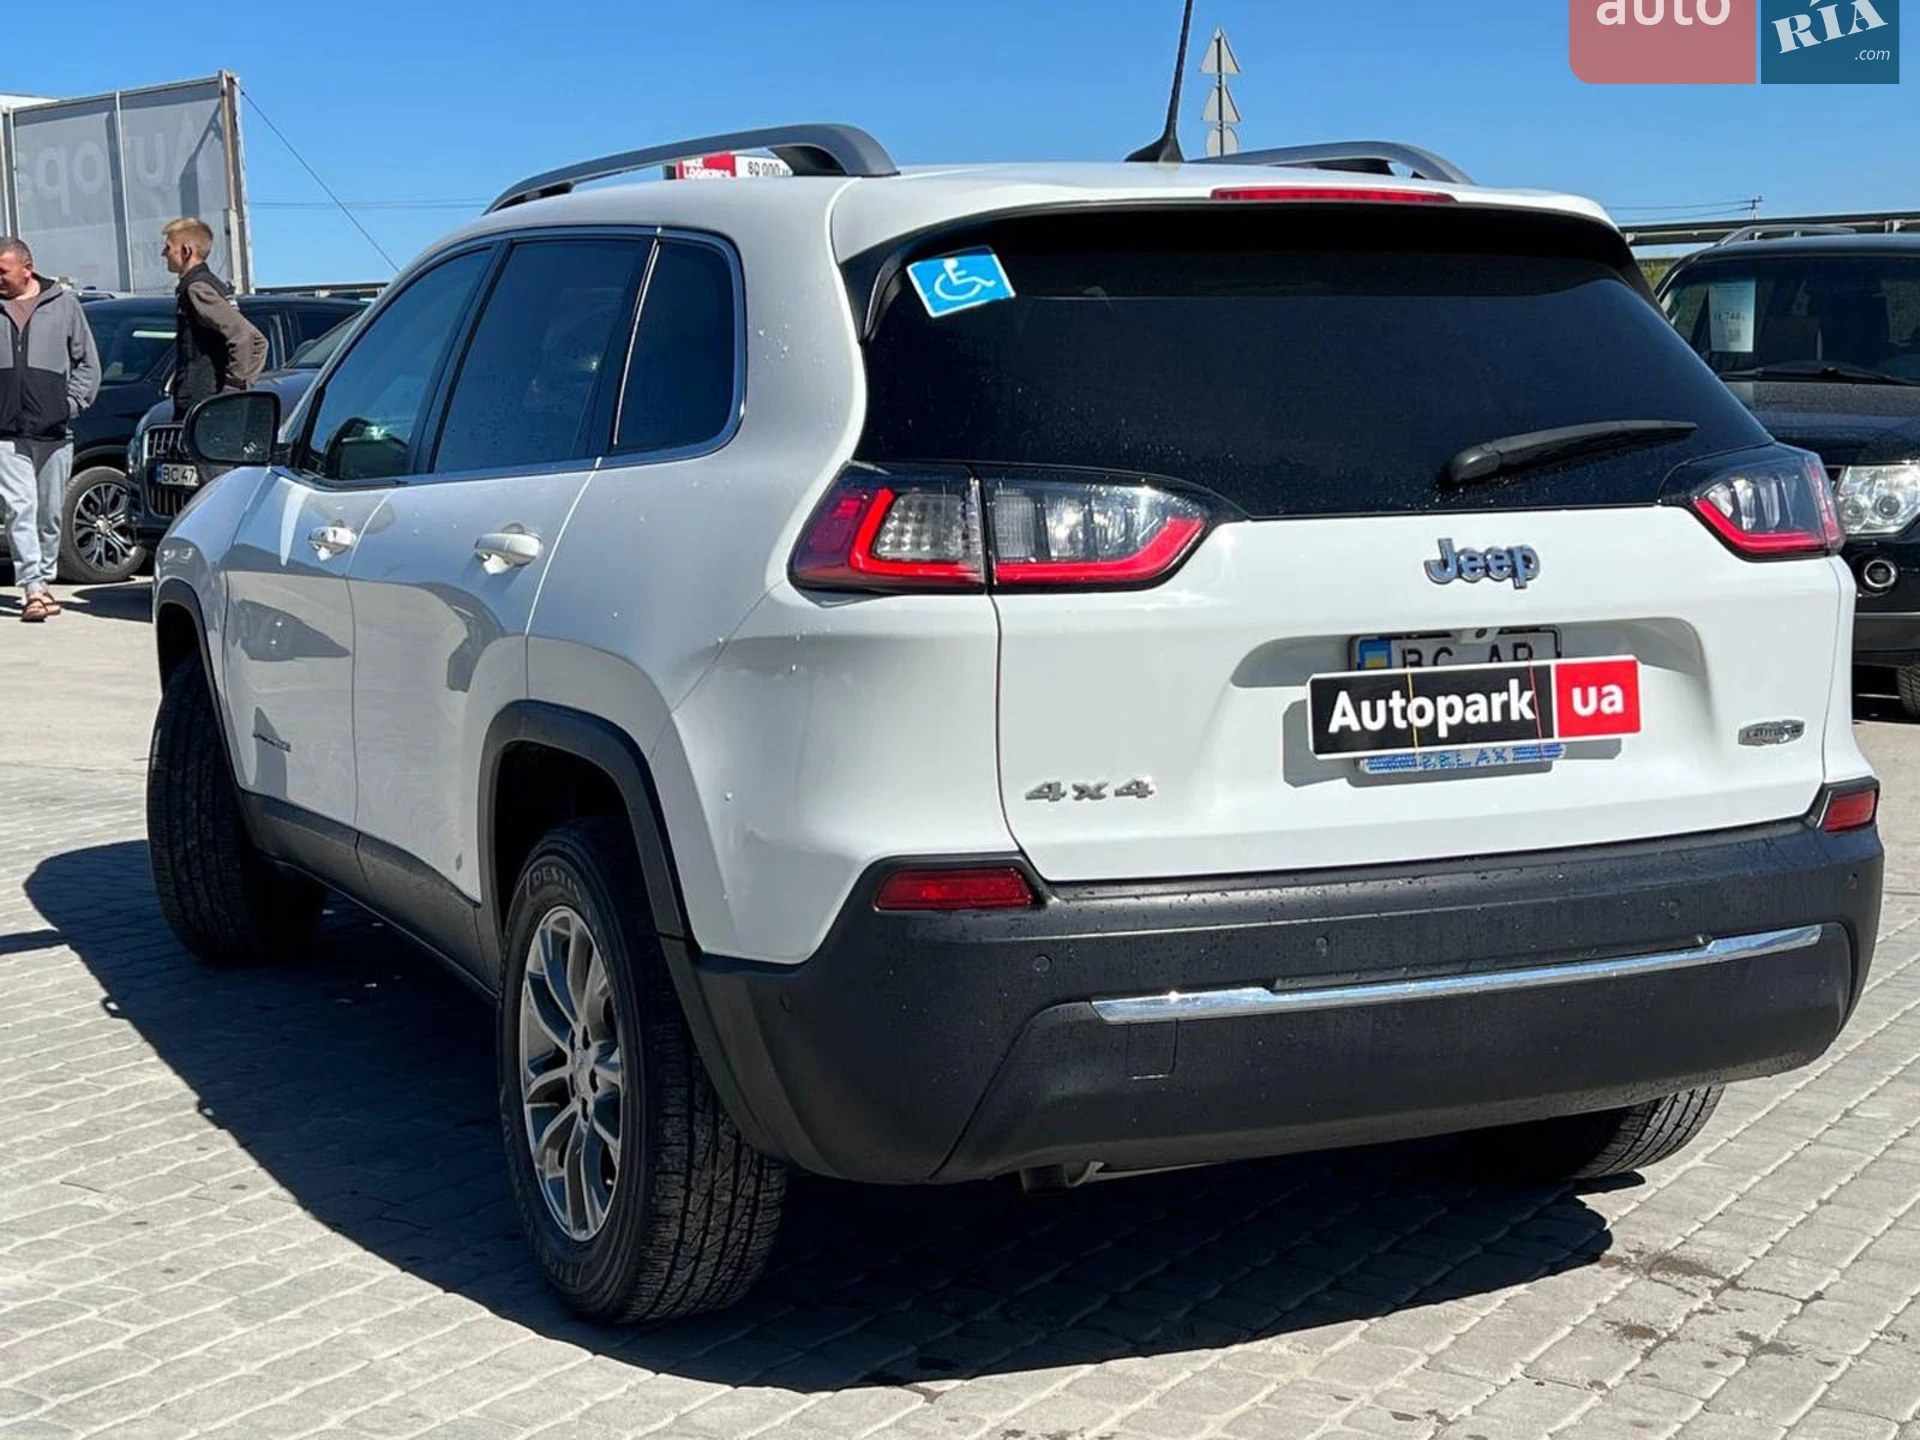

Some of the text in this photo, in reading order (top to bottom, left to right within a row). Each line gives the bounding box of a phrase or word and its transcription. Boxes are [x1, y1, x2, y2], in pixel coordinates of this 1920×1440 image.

[1424, 537, 1541, 590] Jeep
[1327, 678, 1625, 738] Autopark ua
